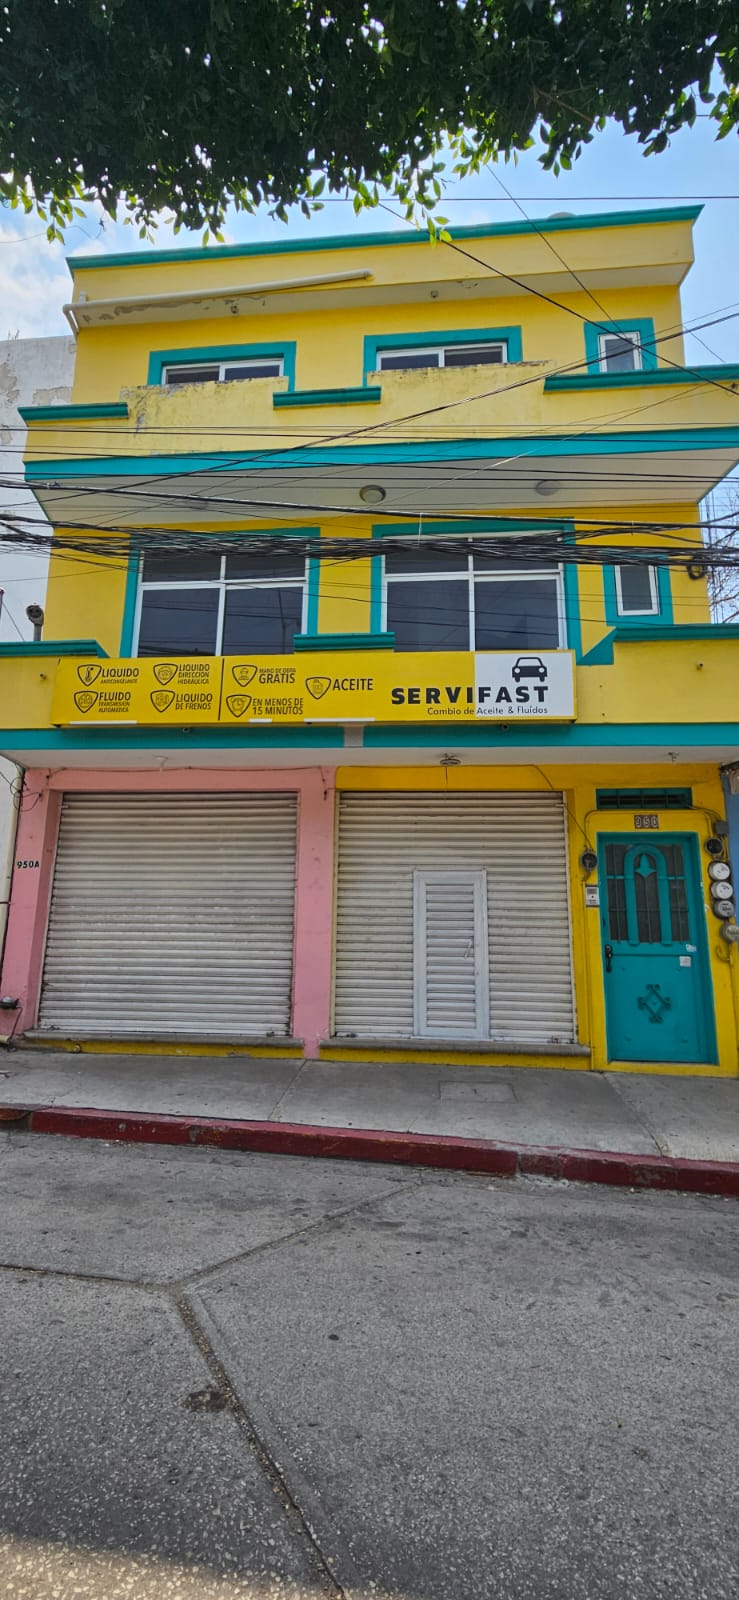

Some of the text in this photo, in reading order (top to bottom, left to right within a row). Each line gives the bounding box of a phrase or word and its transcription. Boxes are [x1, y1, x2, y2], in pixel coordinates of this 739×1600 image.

[101, 668, 139, 677] LIQUIDO
[258, 673, 296, 684] GRATIS
[332, 678, 374, 690] ACEITE
[98, 691, 131, 701] FLUIDO
[176, 693, 213, 702] LIQUIDO
[391, 686, 549, 704] SERVIFAST
[264, 698, 292, 706] MENOS
[294, 698, 304, 706] DE
[252, 706, 304, 715] 15 MINUTOS
[427, 707, 462, 715] Cambio
[477, 707, 504, 715] Aceite
[508, 706, 514, 714] &
